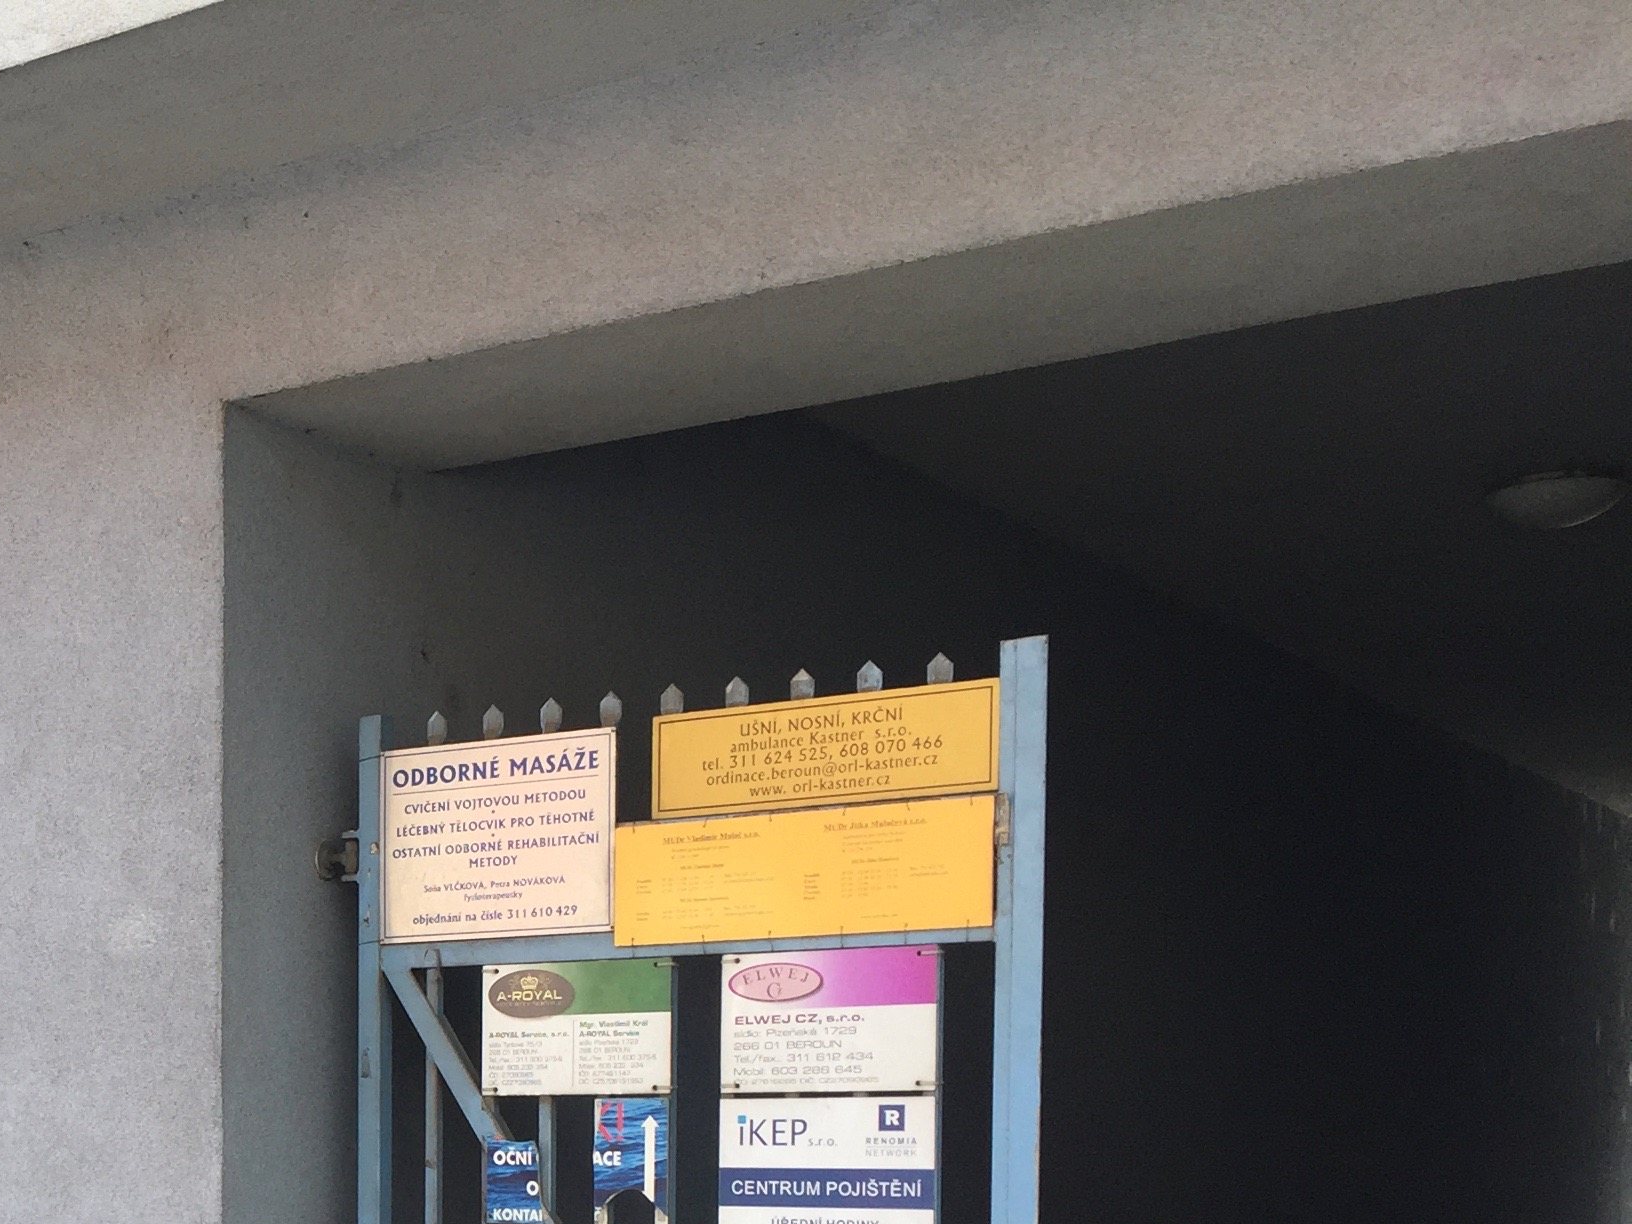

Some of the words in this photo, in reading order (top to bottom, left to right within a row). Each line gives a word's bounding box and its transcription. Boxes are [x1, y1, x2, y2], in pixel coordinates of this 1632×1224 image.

[740, 720, 782, 737] UŠNÍ,
[788, 711, 845, 732] NOSNÍ,
[852, 704, 903, 725] KRČNÍ
[730, 738, 803, 753] ambulance
[809, 729, 864, 745] Kastner
[875, 727, 912, 739] s.r.o.
[702, 757, 724, 771] tel.
[730, 754, 756, 768] 311
[764, 751, 792, 764] 624
[799, 747, 833, 762] 525,
[839, 743, 868, 757] 608
[876, 739, 905, 753] 070
[912, 735, 942, 750] 466
[393, 756, 500, 788] ODBORNÉ
[509, 747, 599, 777] MASÁŽE
[750, 785, 786, 797] www.
[793, 774, 890, 793] orl-kastner.cz
[404, 798, 450, 814] CVIČENÍ
[455, 795, 518, 810] VOJTOVOU
[525, 790, 586, 804] METODOU
[397, 823, 445, 838] LÉČEBNÝ
[450, 818, 505, 834] TĚLOCVIK
[511, 816, 534, 828] PRO
[539, 810, 595, 825] TĚHOTNÉ
[393, 844, 441, 859] OSTATNÍ
[446, 839, 502, 855] ODBORNÉ
[508, 831, 599, 850] REHABILITAČNÍ
[469, 855, 517, 868] METODY
[413, 912, 461, 926] objednání
[466, 913, 476, 922] na
[481, 911, 503, 921] čísle
[507, 908, 527, 919] 311
[530, 907, 552, 918] 610
[556, 905, 577, 916] 429
[742, 967, 810, 985] ELWEJ
[496, 990, 563, 1001] A-ROYAL
[735, 1014, 791, 1025] ELWEJ
[795, 1014, 823, 1025] CZ,
[826, 1014, 865, 1023] s.r.o.
[825, 1026, 857, 1035] 1729
[734, 1042, 760, 1051] 266
[764, 1041, 780, 1050] 01
[787, 1040, 842, 1050] BEROUN
[787, 1053, 810, 1062] 311
[846, 1052, 873, 1061] 434
[772, 1066, 797, 1075] 603
[835, 1065, 862, 1074] 645
[737, 1115, 808, 1146] iKEP
[808, 1138, 838, 1147] s.r.o.
[865, 1137, 917, 1145] RENOMIA
[493, 1147, 532, 1166] OČNÍ
[865, 1149, 917, 1157] NETWORK
[732, 1180, 820, 1196] CENTRUM
[826, 1178, 921, 1197] POJIŠTĚNÍ
